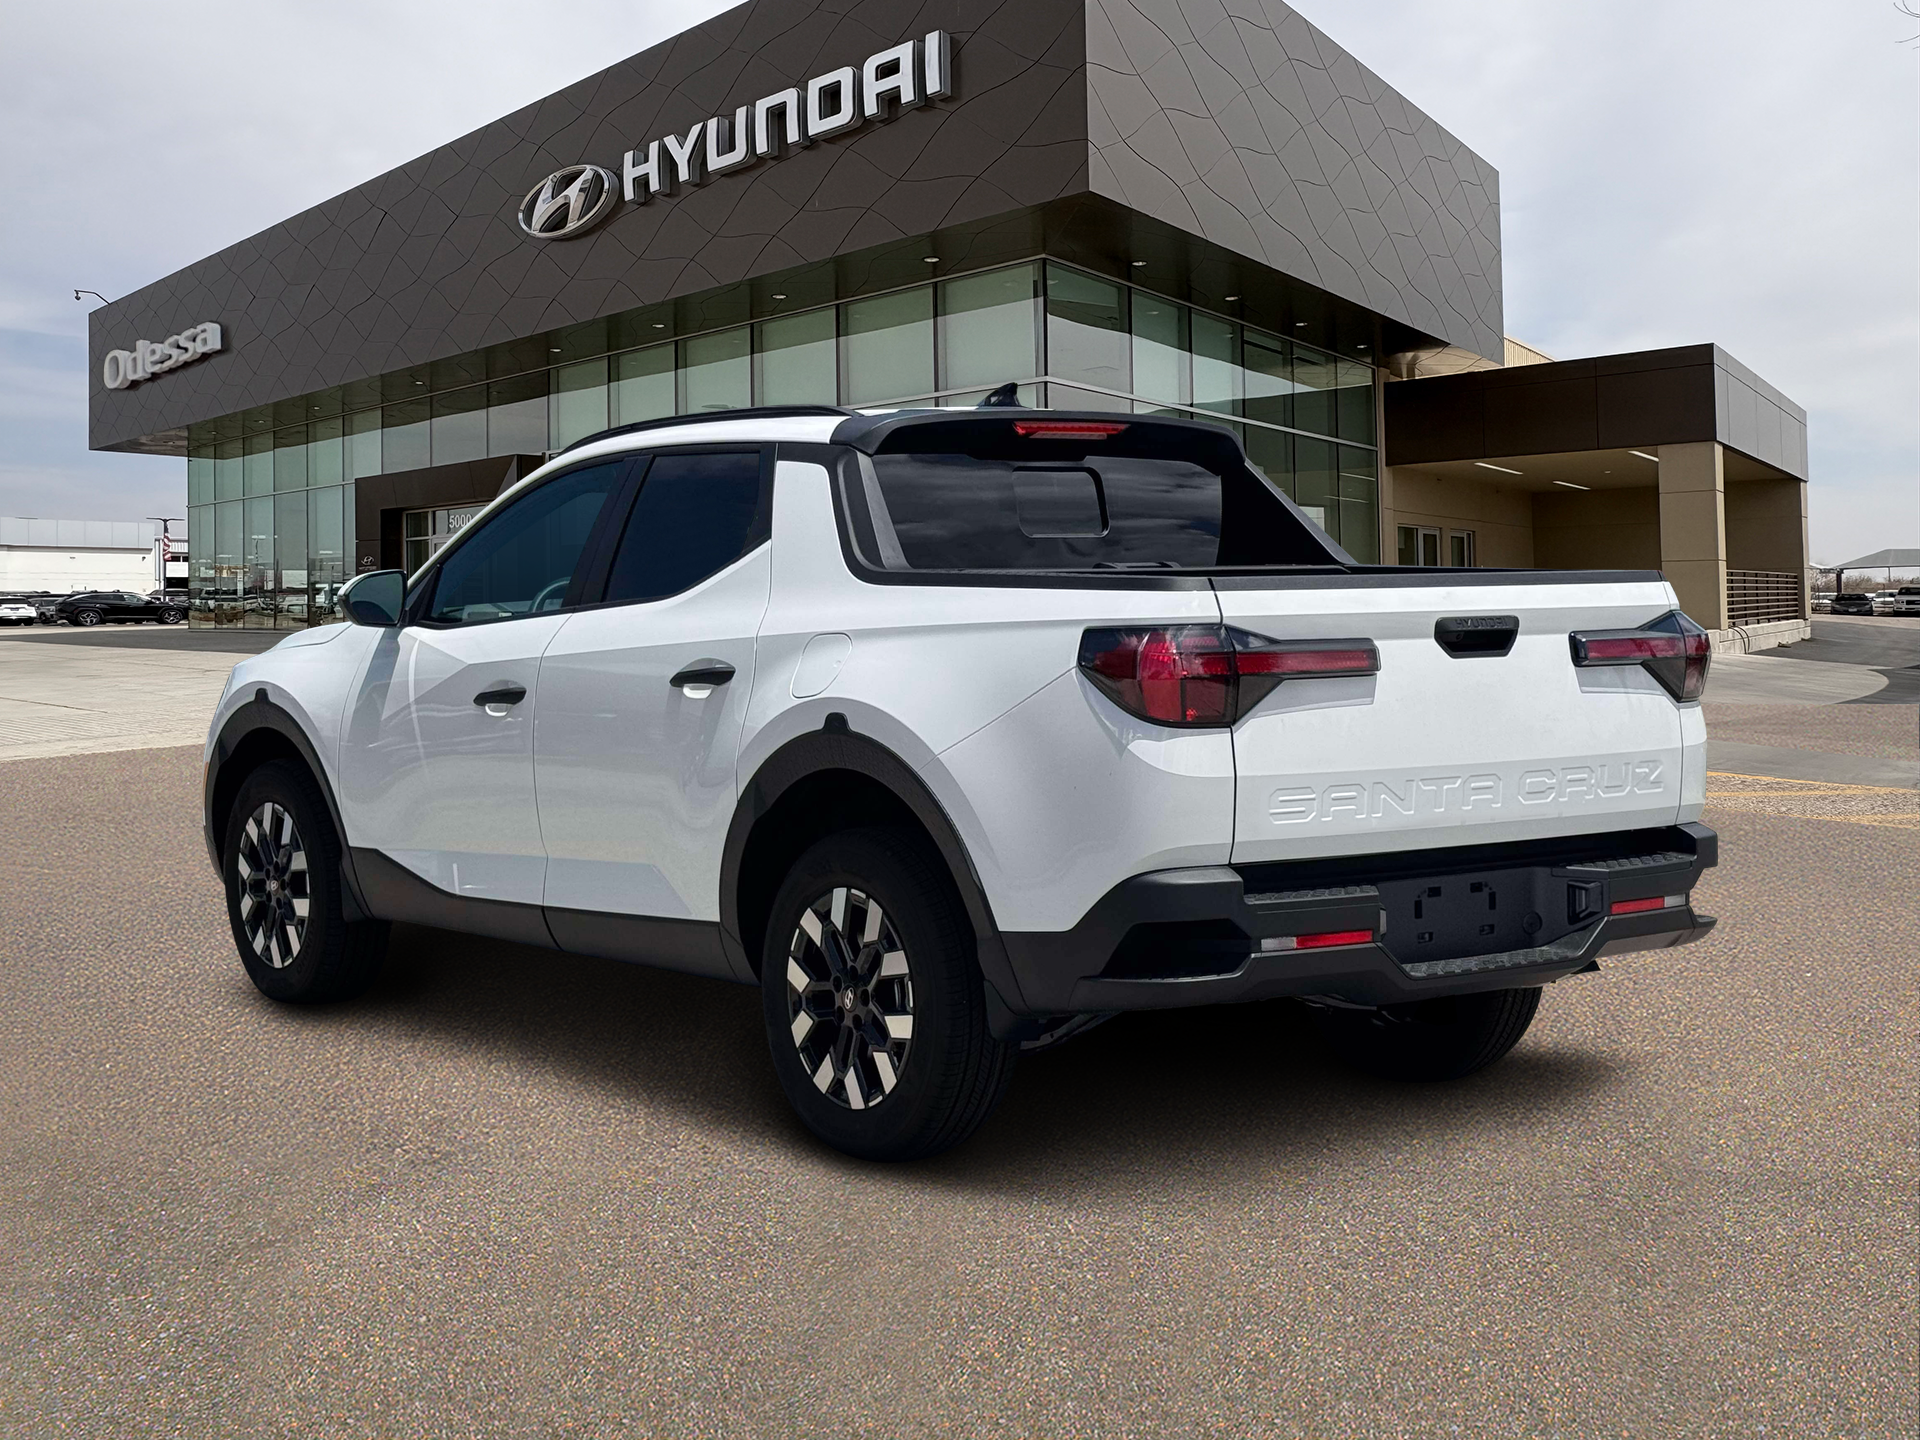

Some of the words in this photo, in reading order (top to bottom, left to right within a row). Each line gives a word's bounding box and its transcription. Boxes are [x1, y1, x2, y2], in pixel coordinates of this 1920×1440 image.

[623, 30, 948, 203] HYUNDAI
[104, 322, 221, 388] Odessa
[1454, 617, 1509, 629] HYUNDAI
[1269, 773, 1502, 824] SANTA
[1518, 760, 1664, 805] CRUZ
